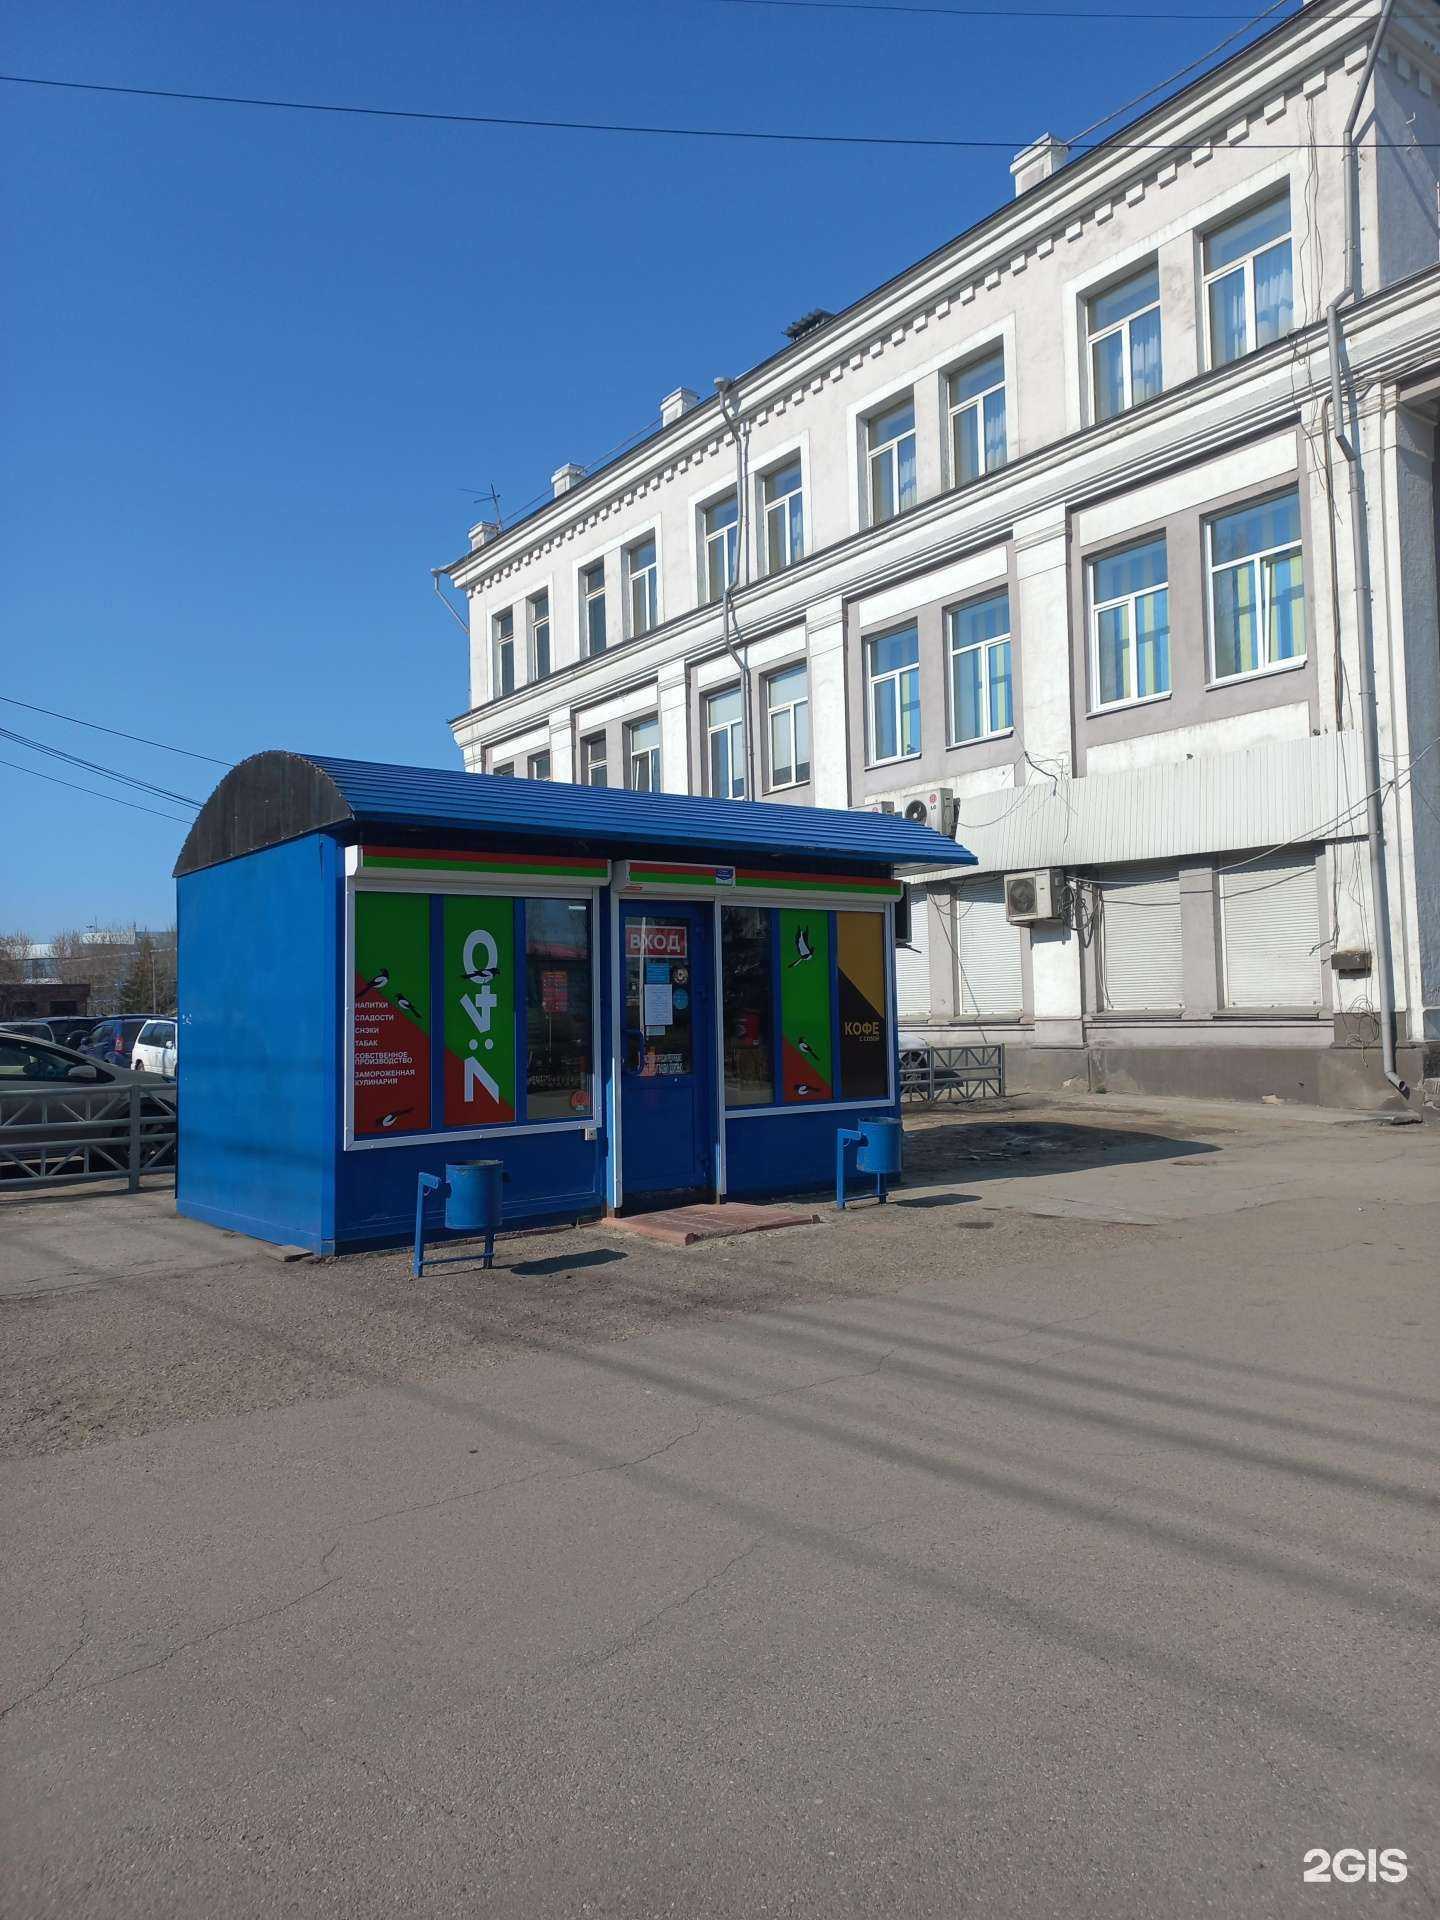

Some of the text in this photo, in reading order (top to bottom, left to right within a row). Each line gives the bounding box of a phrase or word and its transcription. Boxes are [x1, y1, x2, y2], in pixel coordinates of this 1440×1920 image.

[630, 934, 681, 953] ВХОД
[844, 1021, 880, 1036] КОФЕ
[355, 1051, 408, 1059] СОБСТВЕННОЕ
[355, 1057, 413, 1065] ПРОИЗВОДСТВО
[355, 1069, 416, 1078] ЗАМОРОЖЕННАЯ
